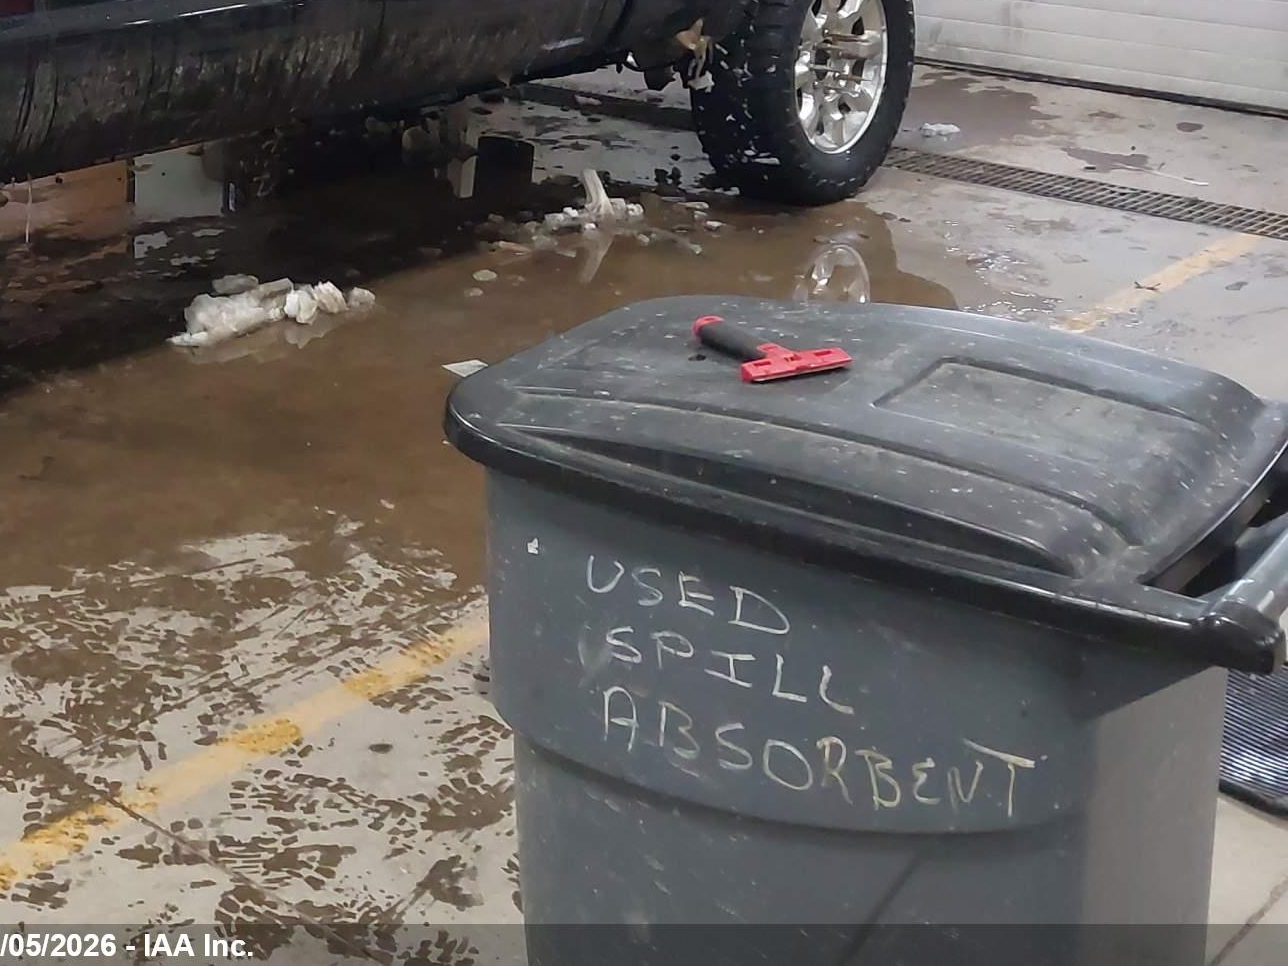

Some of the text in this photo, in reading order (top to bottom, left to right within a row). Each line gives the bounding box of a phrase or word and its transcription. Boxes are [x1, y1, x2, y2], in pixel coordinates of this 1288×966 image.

[587, 554, 790, 635] USED
[605, 625, 854, 715] SPILL
[602, 685, 1036, 819] ABSORBENT
